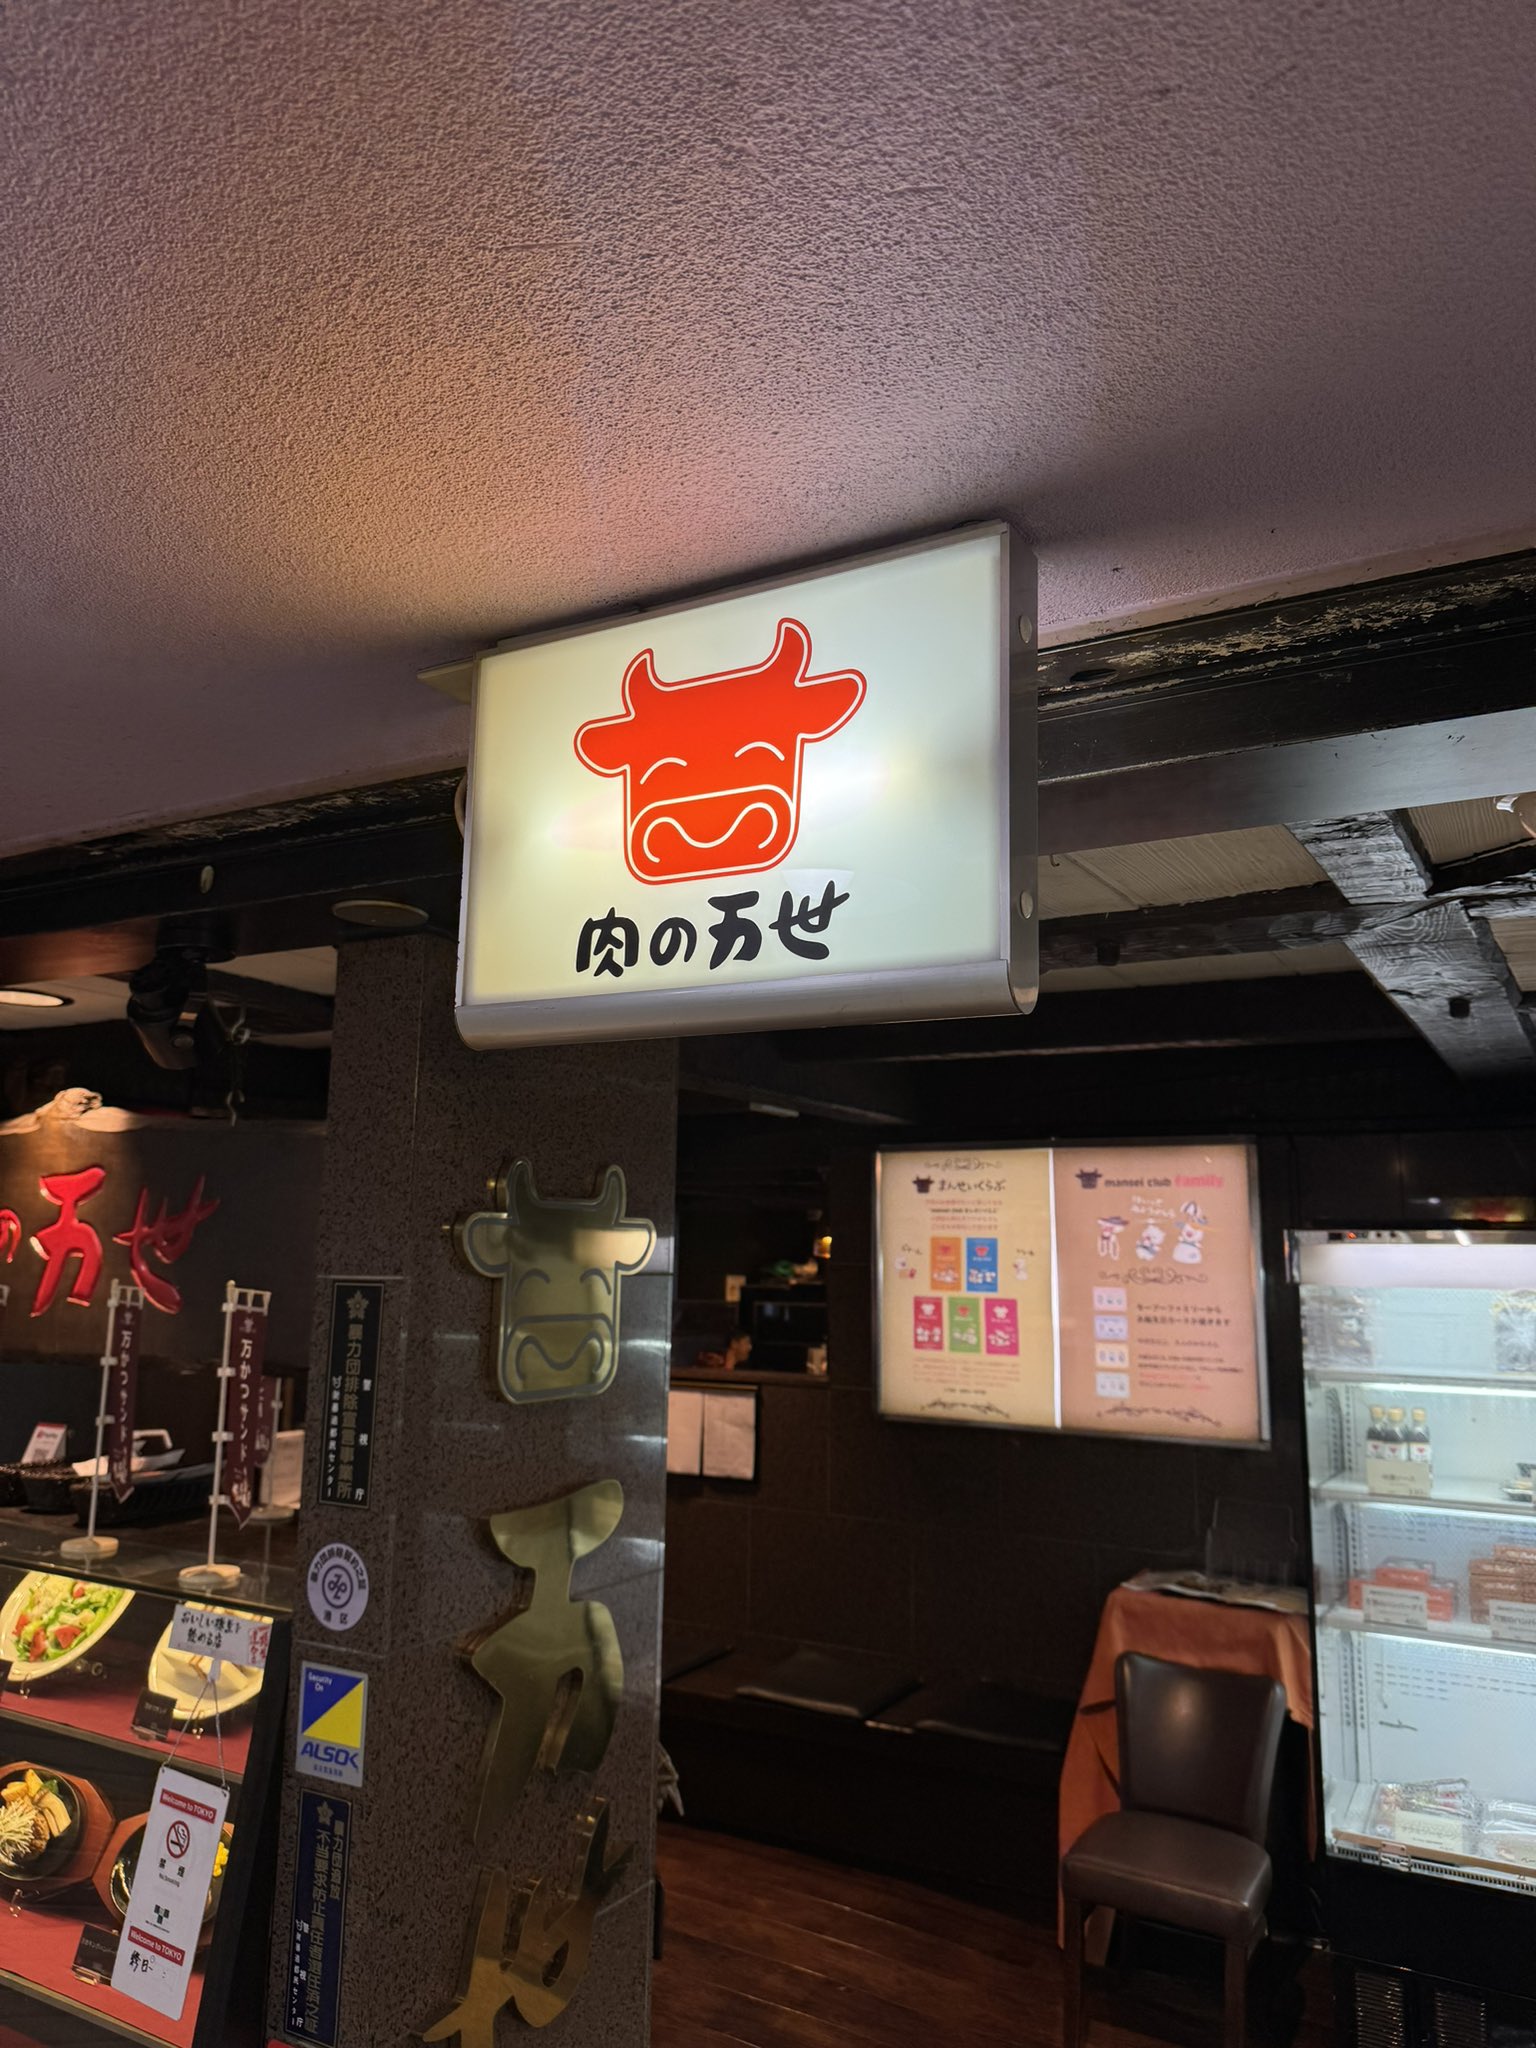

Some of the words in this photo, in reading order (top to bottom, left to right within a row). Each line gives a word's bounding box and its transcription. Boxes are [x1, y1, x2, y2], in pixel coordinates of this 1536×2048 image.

[576, 880, 850, 977] 肉の万世
[1104, 1177, 1144, 1187] mansei
[1147, 1177, 1171, 1187] club
[238, 1338, 254, 1462] 万かつサンド
[301, 1741, 359, 1772] ALSOK
[162, 1792, 187, 1811] Welcome
[193, 1804, 215, 1821] TOKYO
[130, 1929, 154, 1948] Welcome
[161, 1945, 182, 1961] TOKYO
